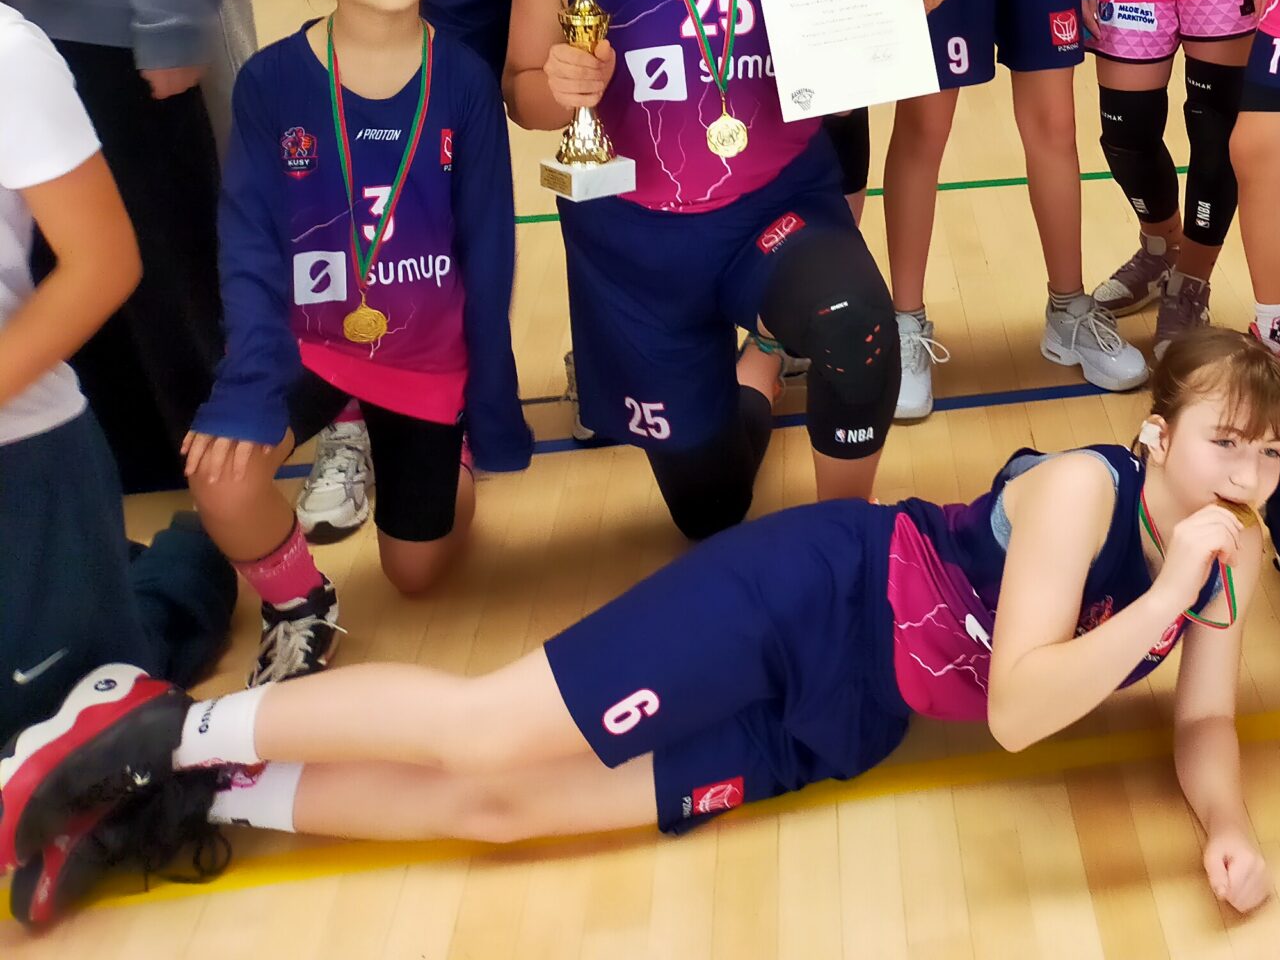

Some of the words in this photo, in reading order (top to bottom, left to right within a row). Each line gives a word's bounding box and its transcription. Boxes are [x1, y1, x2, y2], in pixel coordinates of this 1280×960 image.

[699, 54, 775, 83] sum
[947, 36, 969, 74] 9
[363, 128, 401, 140] PROTON
[287, 158, 310, 166] KUSY
[363, 186, 395, 242] 3
[1197, 200, 1211, 221] NBA
[365, 254, 451, 288] sumup
[624, 395, 671, 440] 25
[847, 427, 874, 444] NBA
[602, 688, 660, 735] 6
